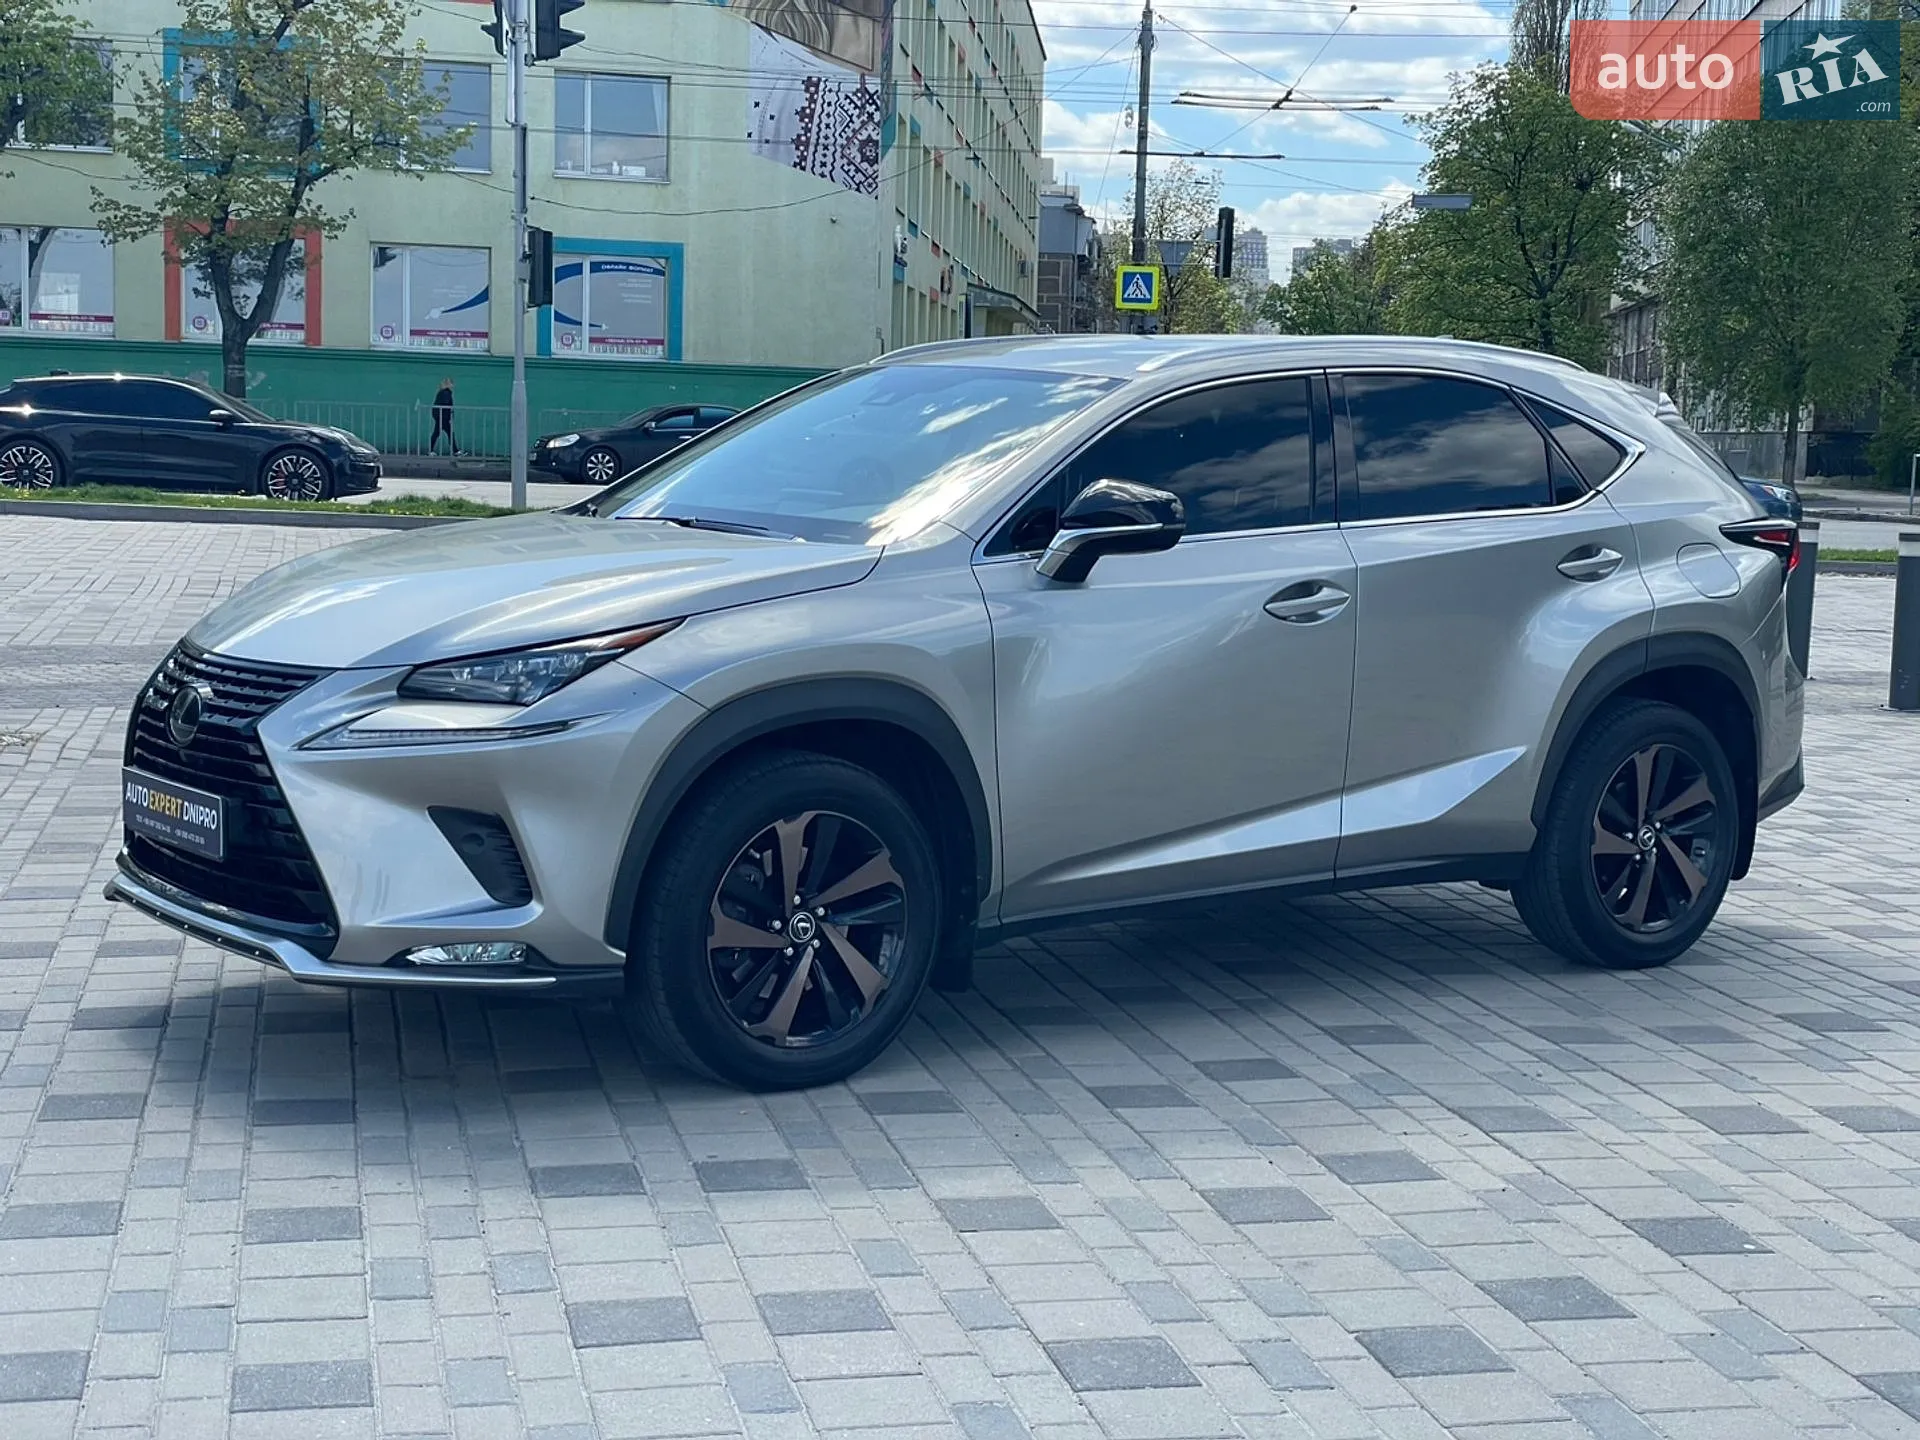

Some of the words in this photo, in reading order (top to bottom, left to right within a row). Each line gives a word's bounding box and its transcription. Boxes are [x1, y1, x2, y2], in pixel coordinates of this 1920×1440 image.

[125, 782, 148, 807] AUTO
[149, 790, 183, 819] EXPERT
[183, 801, 218, 830] DNIPRO
